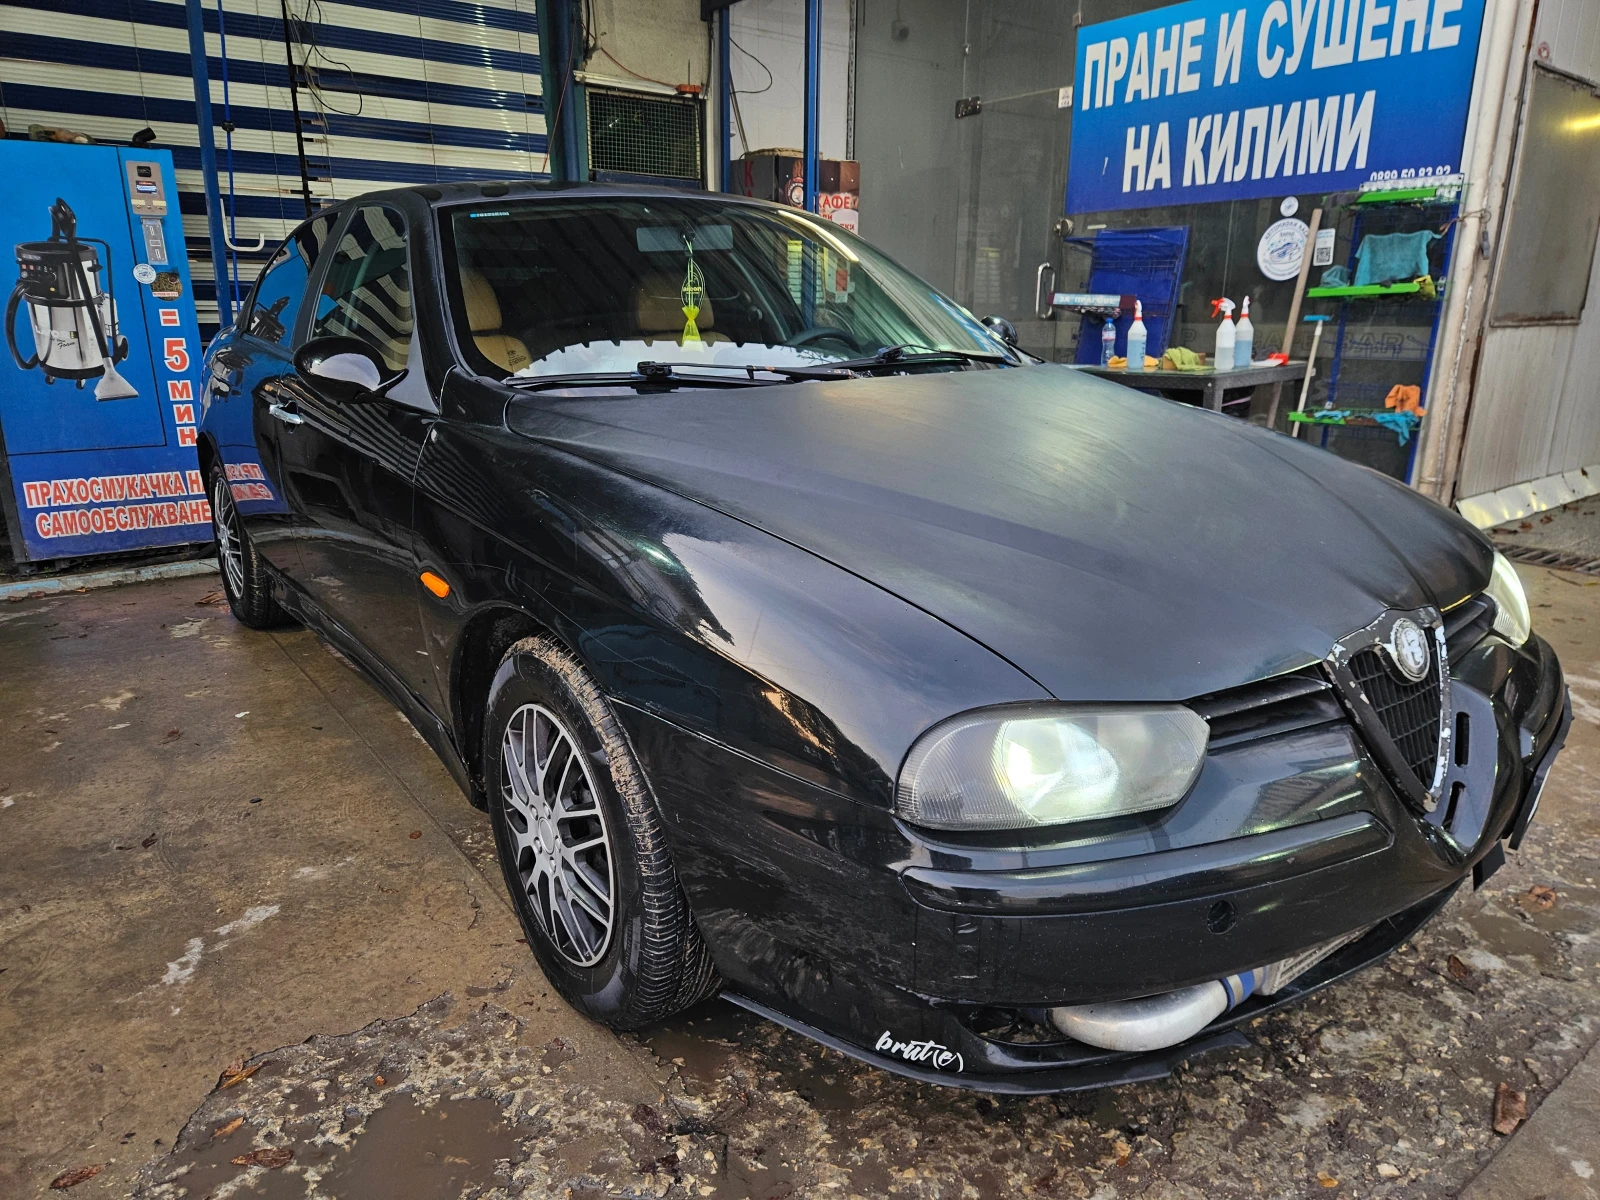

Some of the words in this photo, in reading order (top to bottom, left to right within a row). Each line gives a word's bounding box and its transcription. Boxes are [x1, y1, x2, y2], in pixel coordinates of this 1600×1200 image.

[1081, 18, 1206, 111] ПРАНЕ
[1213, 8, 1247, 88] И
[1256, 0, 1462, 79] СУШЕНЕ
[1122, 121, 1172, 193] НА
[1182, 90, 1376, 187] КИЛИМИ
[164, 338, 189, 372] 5
[22, 471, 187, 508] ПРАХОСМУКАЧКА
[185, 470, 207, 495] Н
[35, 499, 213, 539] САМООБСЛУЖВАНЕ
